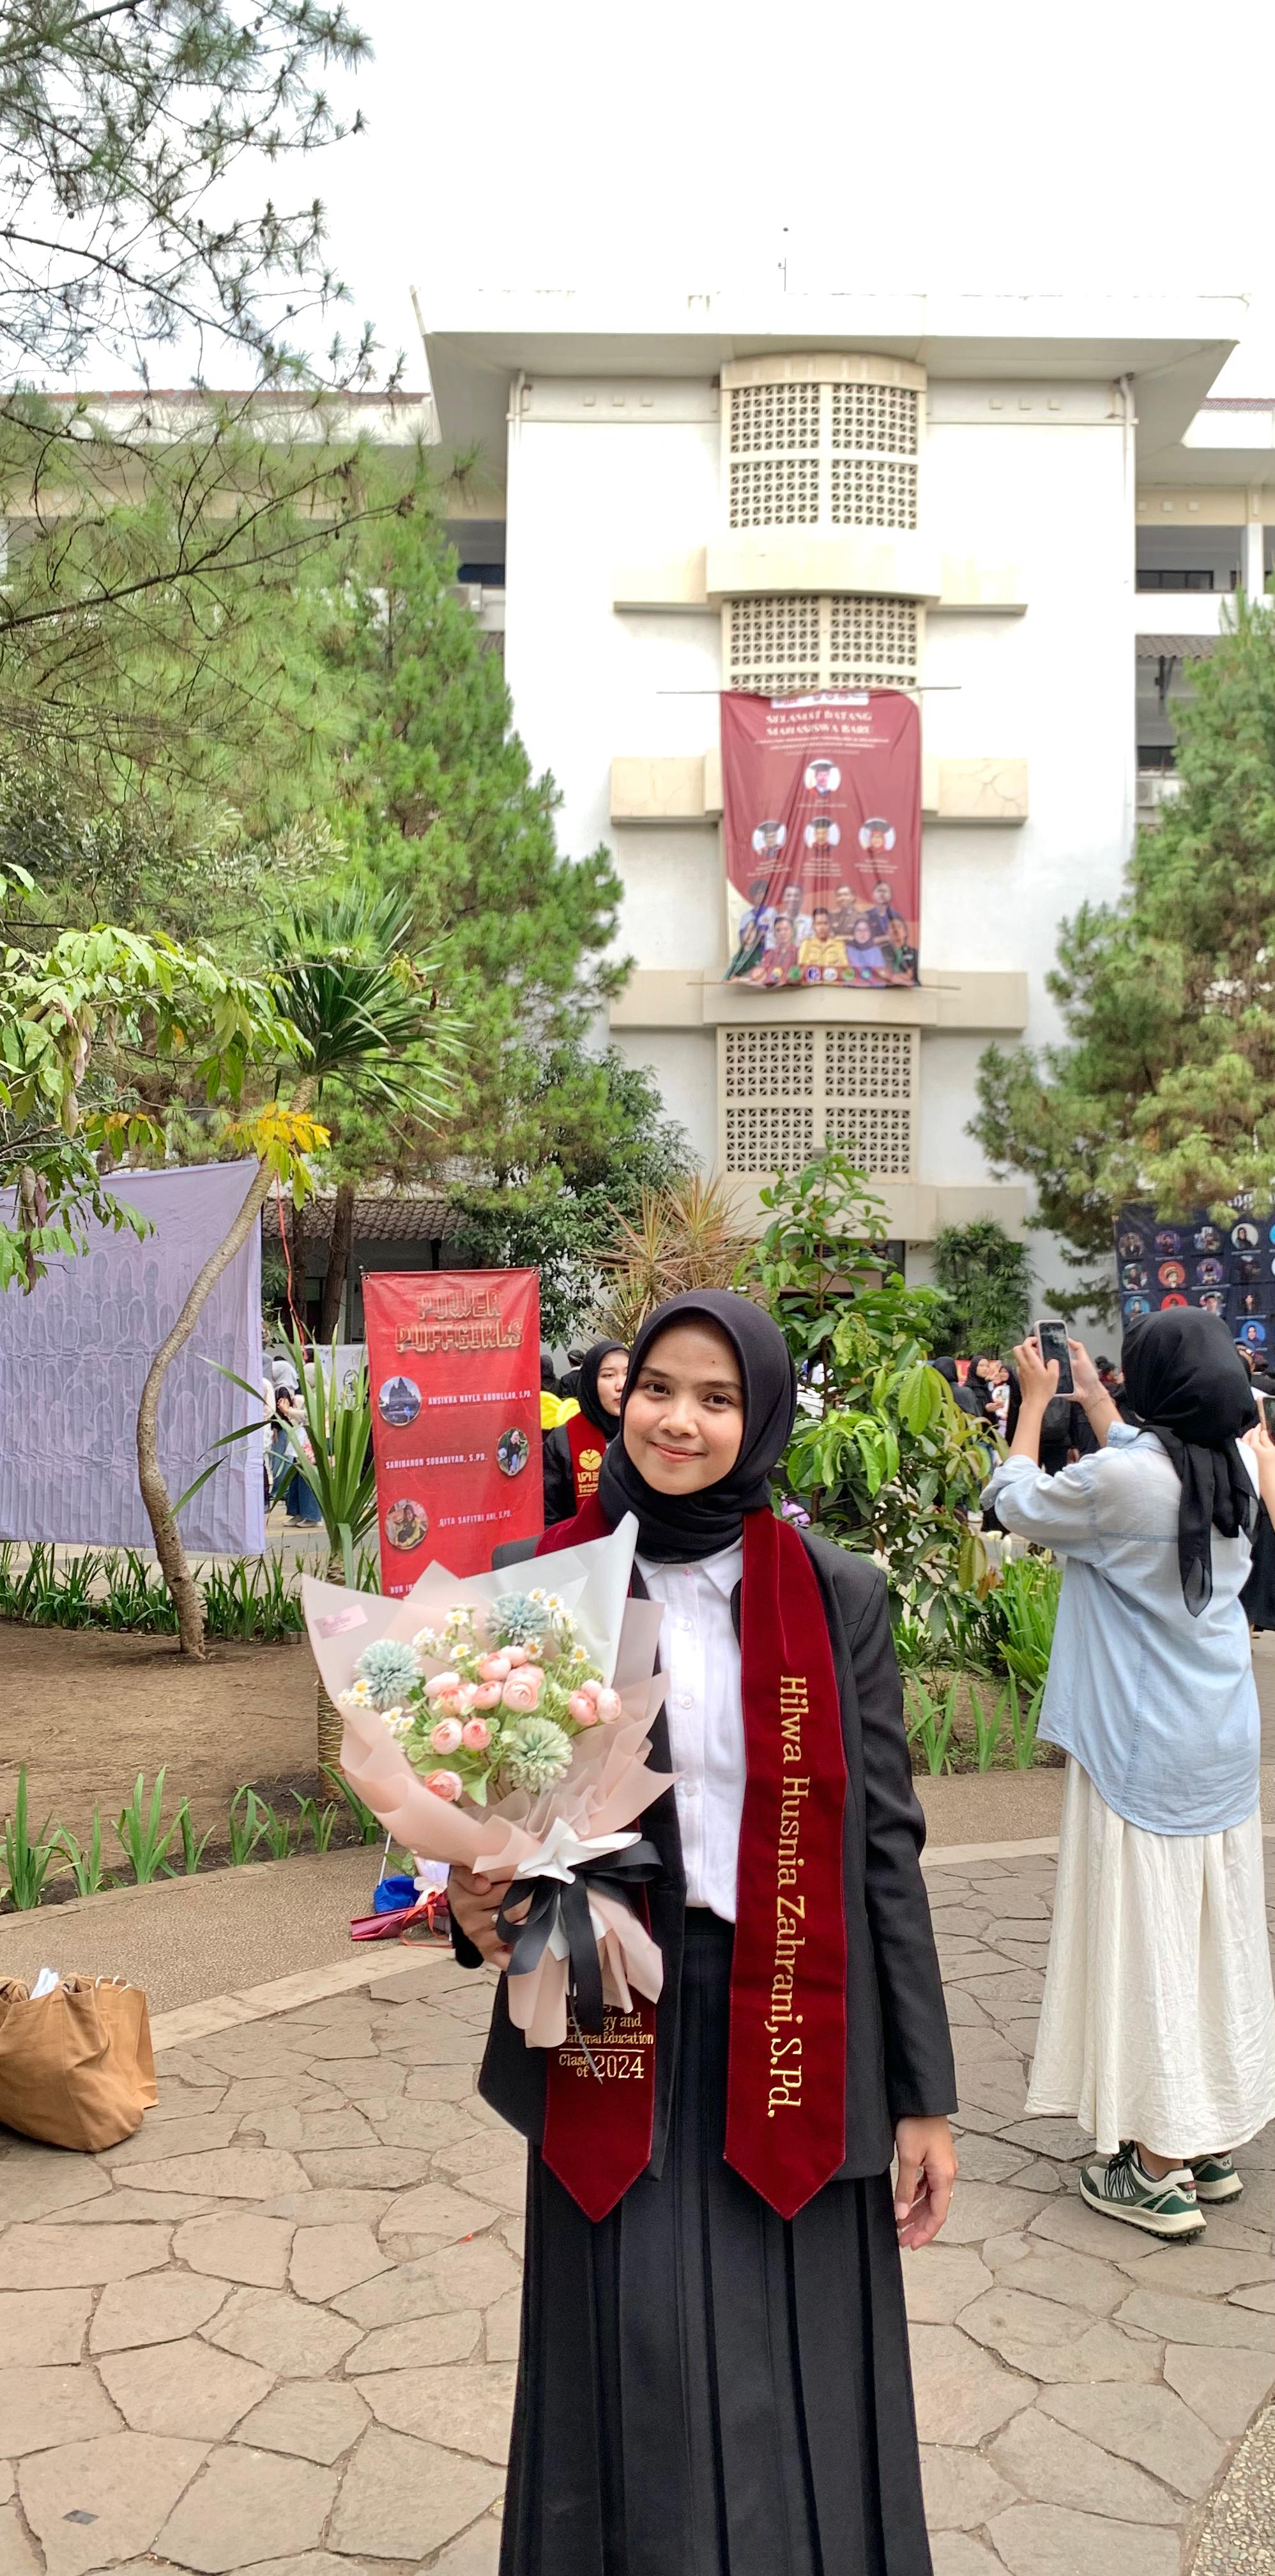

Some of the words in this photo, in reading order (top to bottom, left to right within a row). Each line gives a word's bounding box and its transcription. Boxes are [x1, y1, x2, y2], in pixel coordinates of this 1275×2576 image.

[418, 1287, 503, 1321] POWER
[459, 1393, 480, 1403] NAYLA
[780, 1675, 809, 1765] Hilwa
[777, 1775, 811, 1890] Husnia
[619, 2011, 643, 2028] and
[602, 2030, 655, 2045] Education
[558, 2053, 590, 2067] Class
[576, 2066, 590, 2078] of
[593, 2054, 645, 2080] 2024
